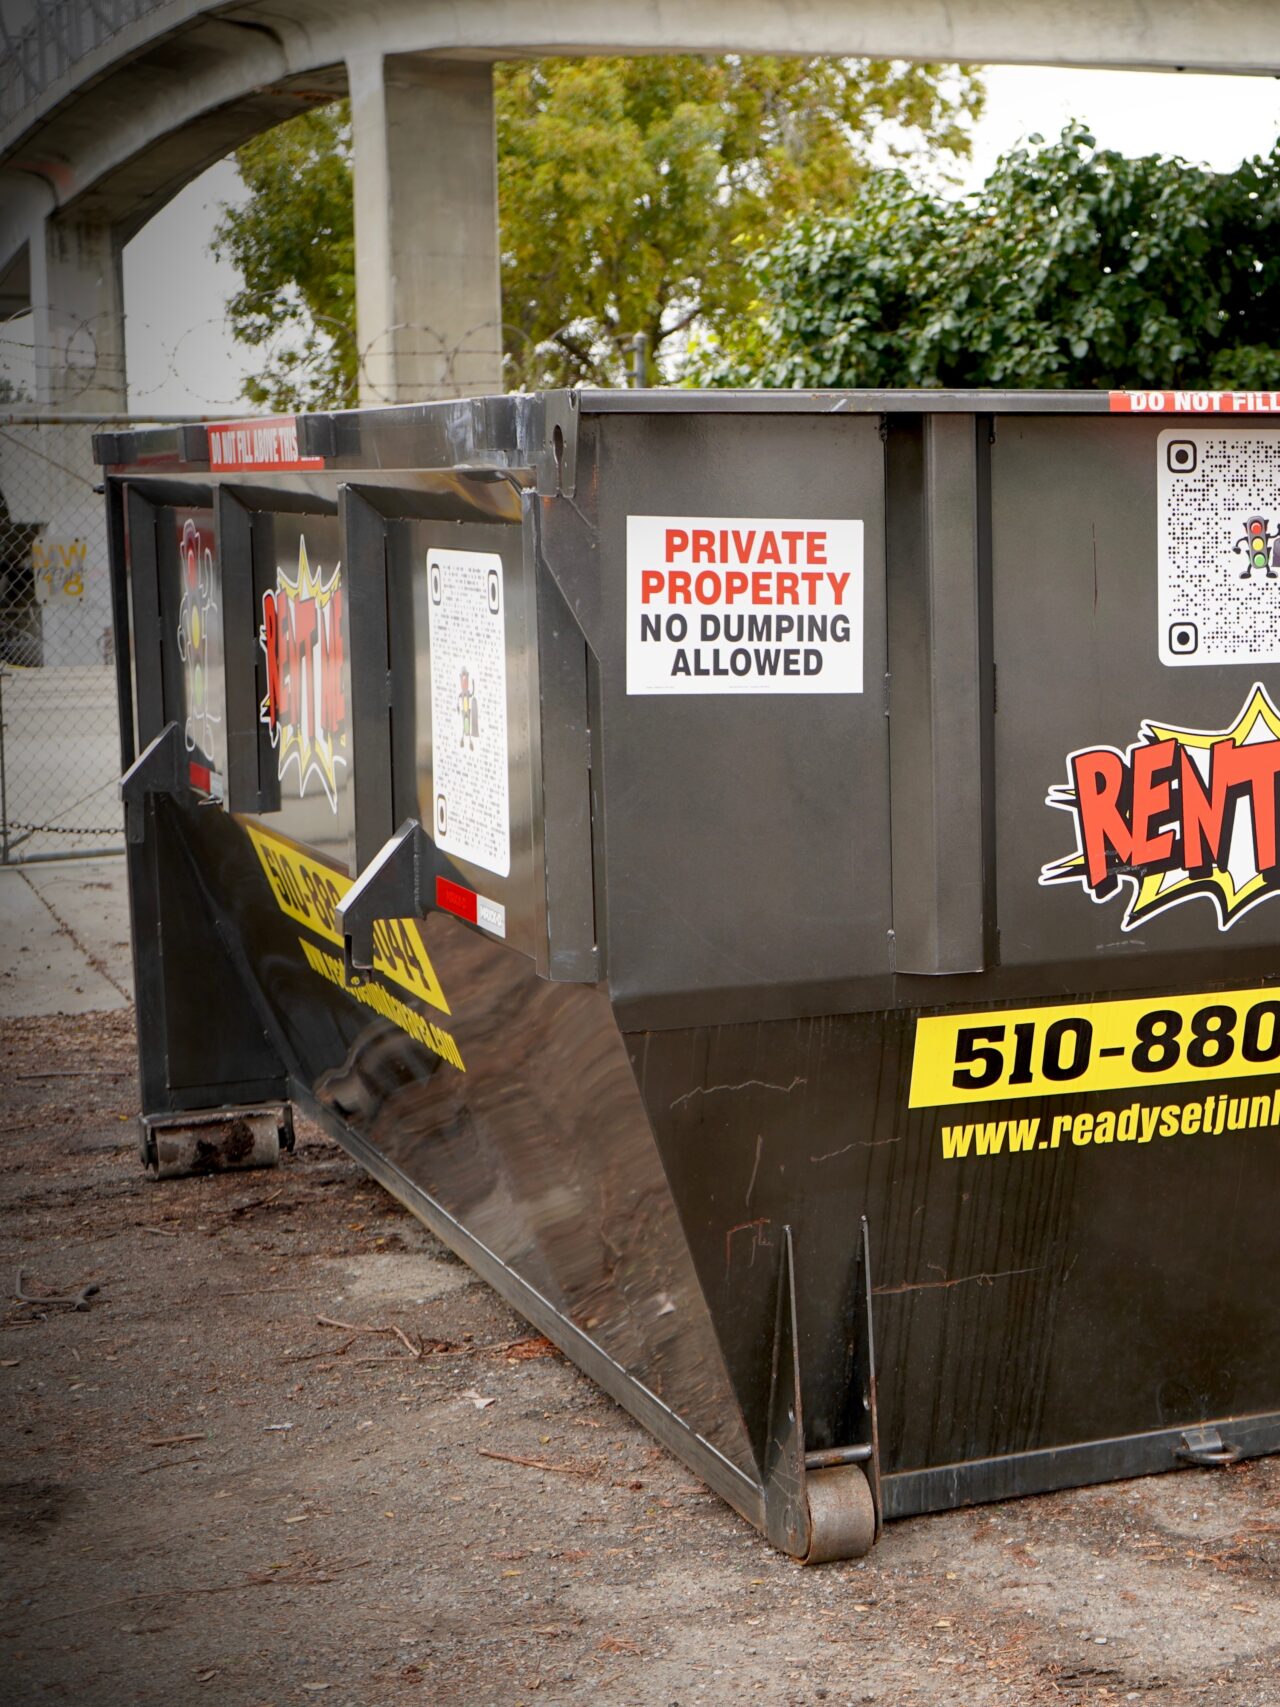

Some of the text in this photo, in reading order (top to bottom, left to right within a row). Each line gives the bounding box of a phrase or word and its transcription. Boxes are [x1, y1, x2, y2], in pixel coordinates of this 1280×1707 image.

[1130, 392, 1165, 412] DO
[1174, 392, 1223, 412] NOT
[211, 431, 222, 464] DO
[221, 430, 236, 464] NOT
[236, 429, 253, 463] FILL
[252, 427, 279, 463] ABOVE
[665, 528, 828, 564] PRIVATE
[641, 570, 851, 605] PROPERTY
[641, 613, 851, 643] NO DUMPING
[264, 587, 317, 739] RENT
[671, 648, 823, 676] ALLOWED
